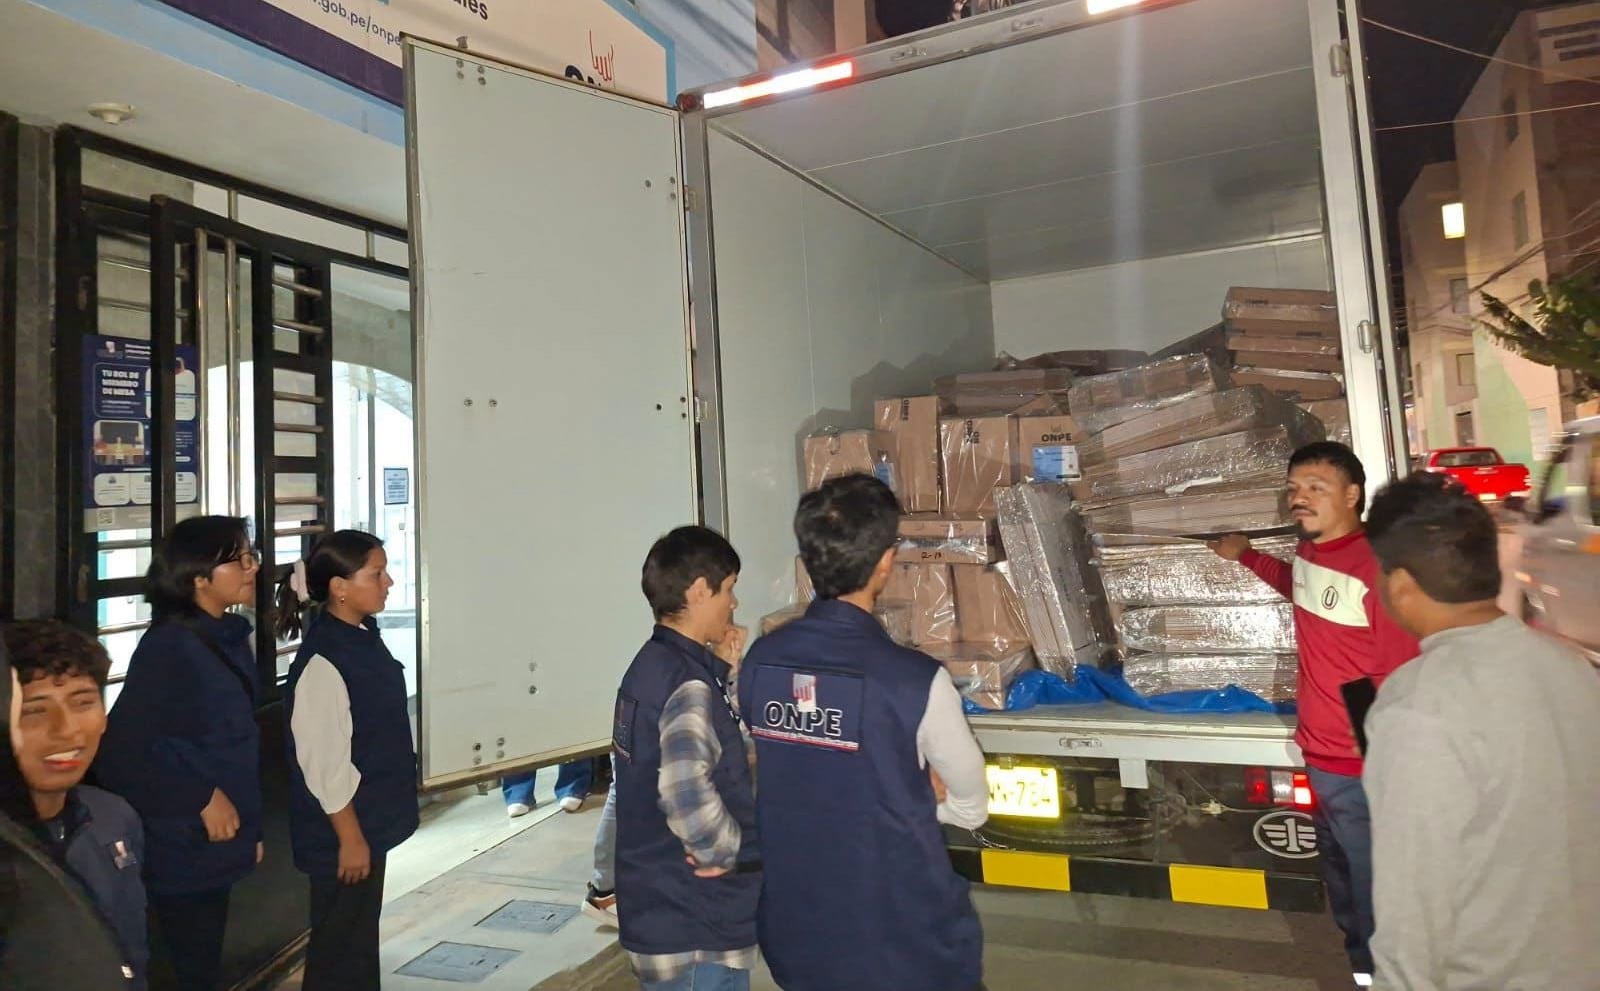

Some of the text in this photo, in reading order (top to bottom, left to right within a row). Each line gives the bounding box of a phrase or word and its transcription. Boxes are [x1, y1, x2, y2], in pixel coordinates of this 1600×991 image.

[312, 0, 402, 46] .gob.pe/onpe
[1041, 432, 1072, 442] ONPE
[763, 700, 843, 737] ONPE
